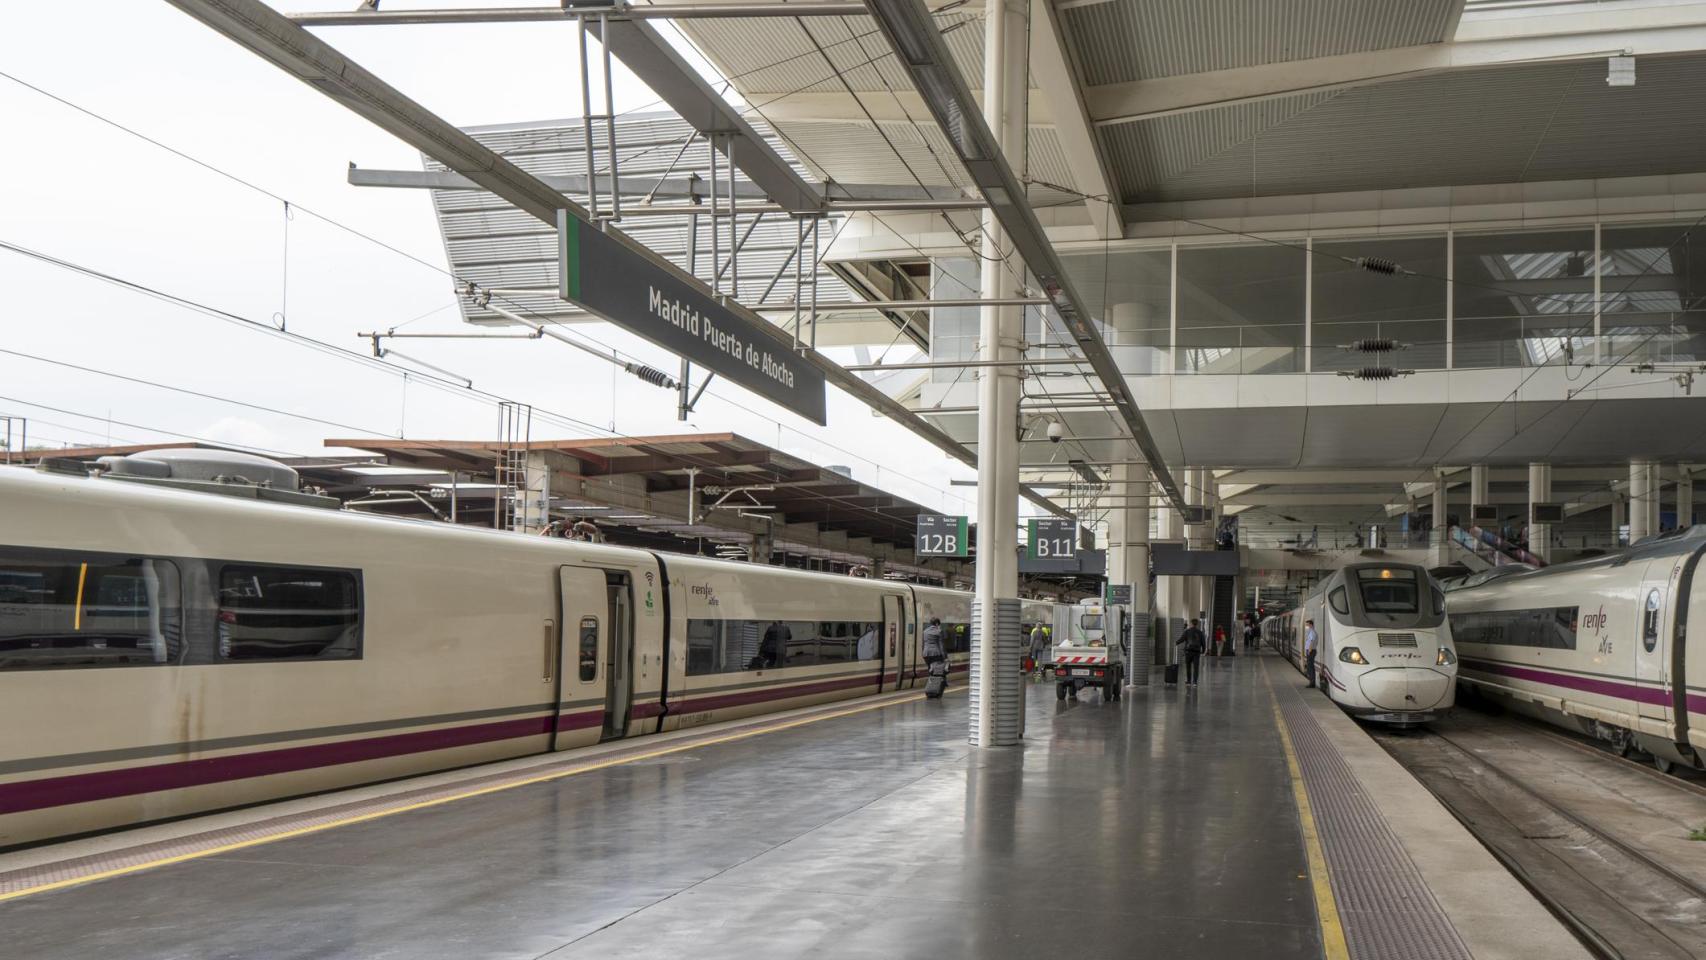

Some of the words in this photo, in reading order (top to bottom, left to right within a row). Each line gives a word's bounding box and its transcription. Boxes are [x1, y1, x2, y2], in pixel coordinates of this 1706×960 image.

[649, 285, 699, 337] Madrid
[703, 316, 742, 361] Puerta
[745, 342, 759, 370] de
[761, 351, 794, 389] Atocha
[691, 583, 713, 600] renfe
[1582, 604, 1607, 637] renfe
[1598, 634, 1613, 655] AVE
